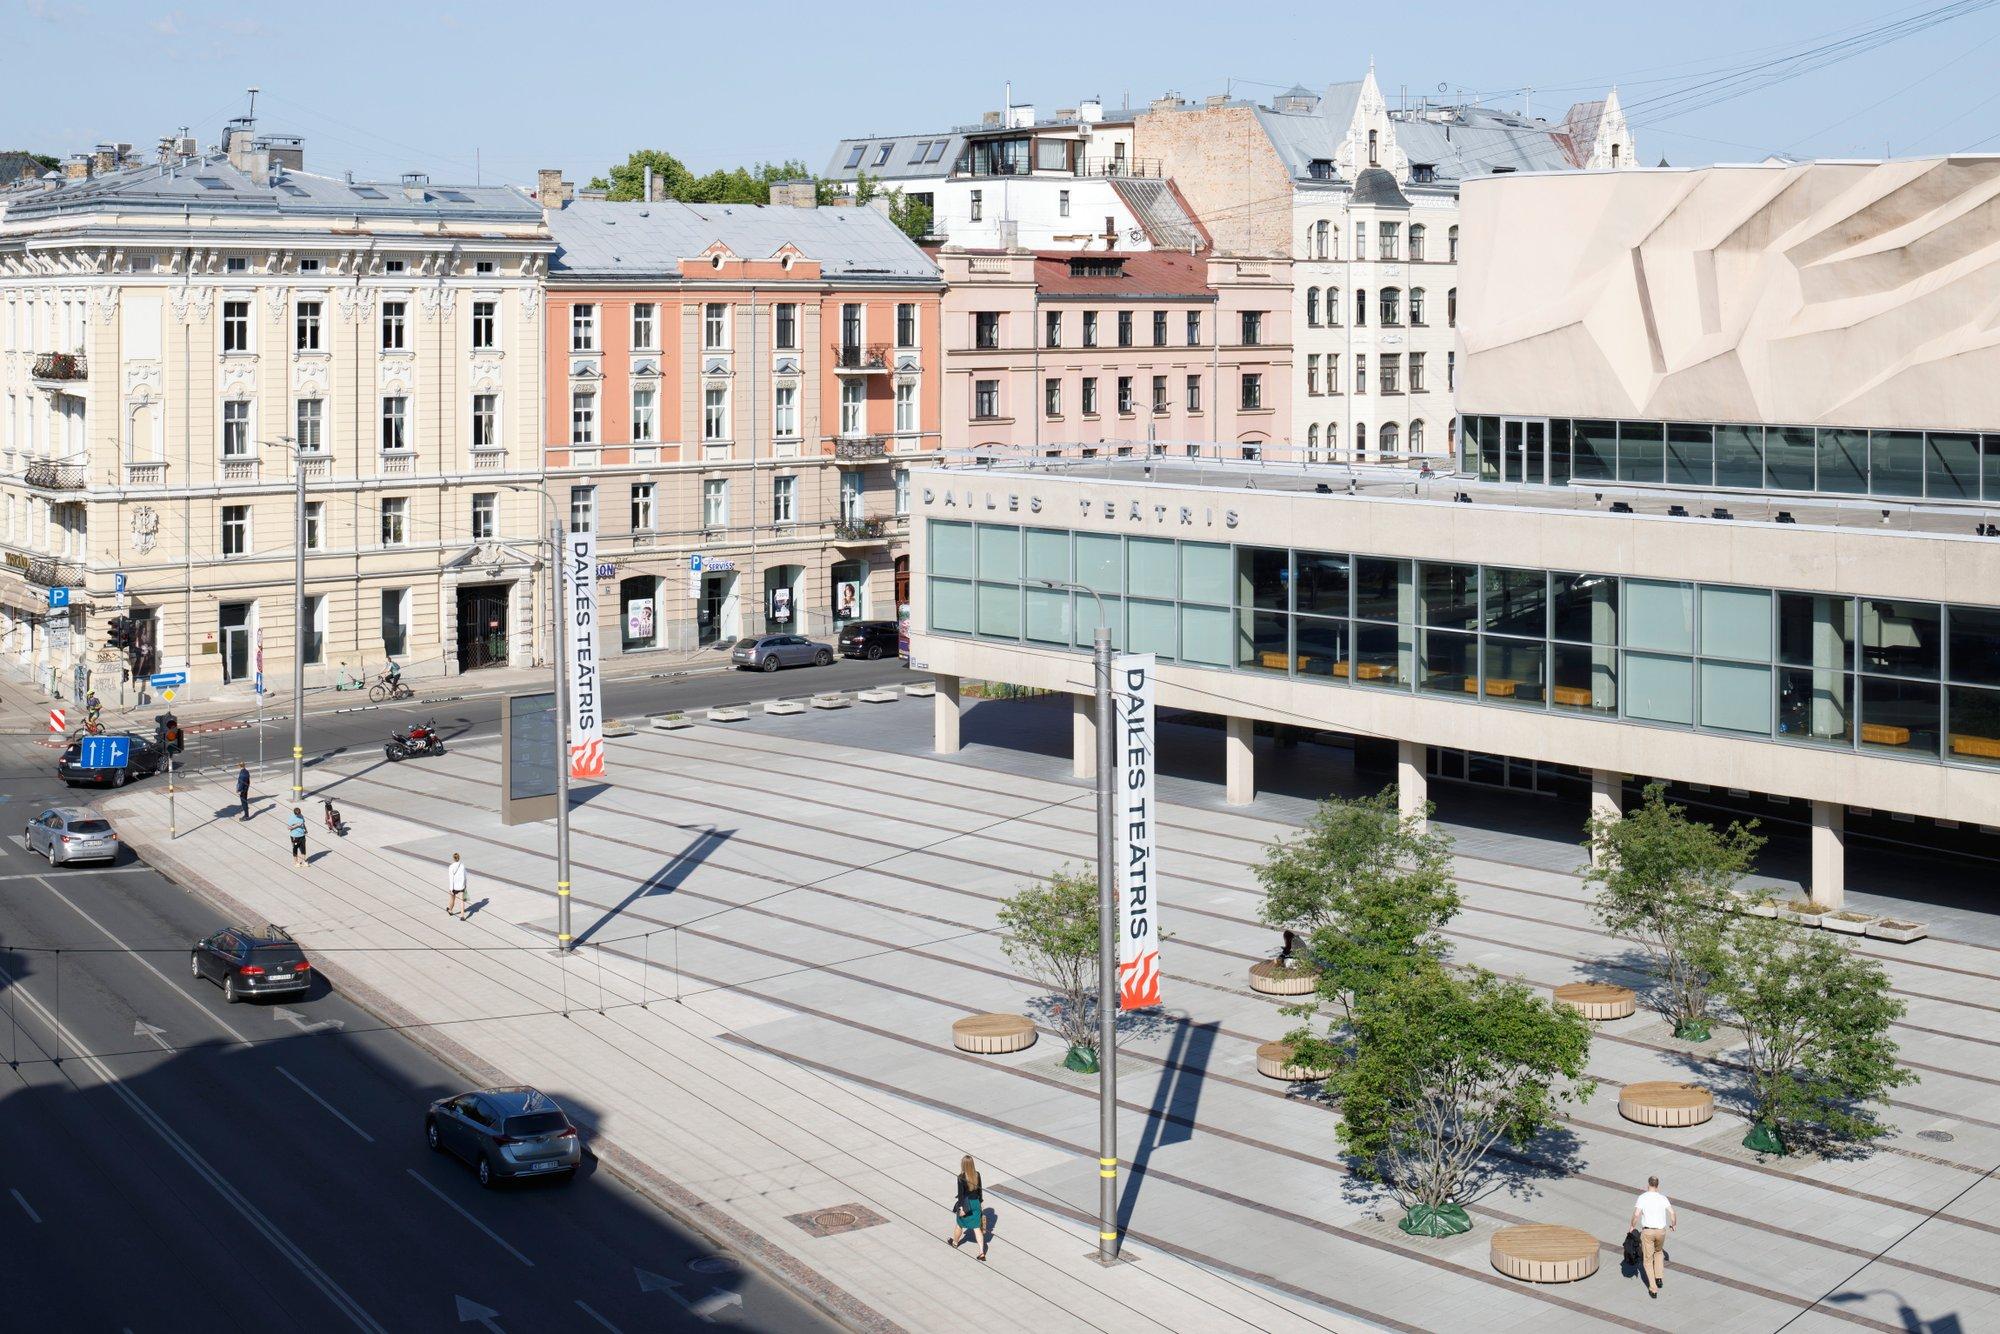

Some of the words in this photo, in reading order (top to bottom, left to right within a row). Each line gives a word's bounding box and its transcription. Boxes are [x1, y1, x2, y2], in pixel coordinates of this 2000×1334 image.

[923, 488, 1042, 513] DAILES
[1080, 499, 1239, 529] TEĀTRIS
[116, 575, 122, 590] P
[574, 542, 590, 626] DAILES
[692, 556, 700, 570] P
[53, 590, 64, 604] P
[577, 632, 595, 730] TEĀTRIS
[1127, 668, 1145, 790] DAILES
[1128, 798, 1150, 940] TEĀTRIS
